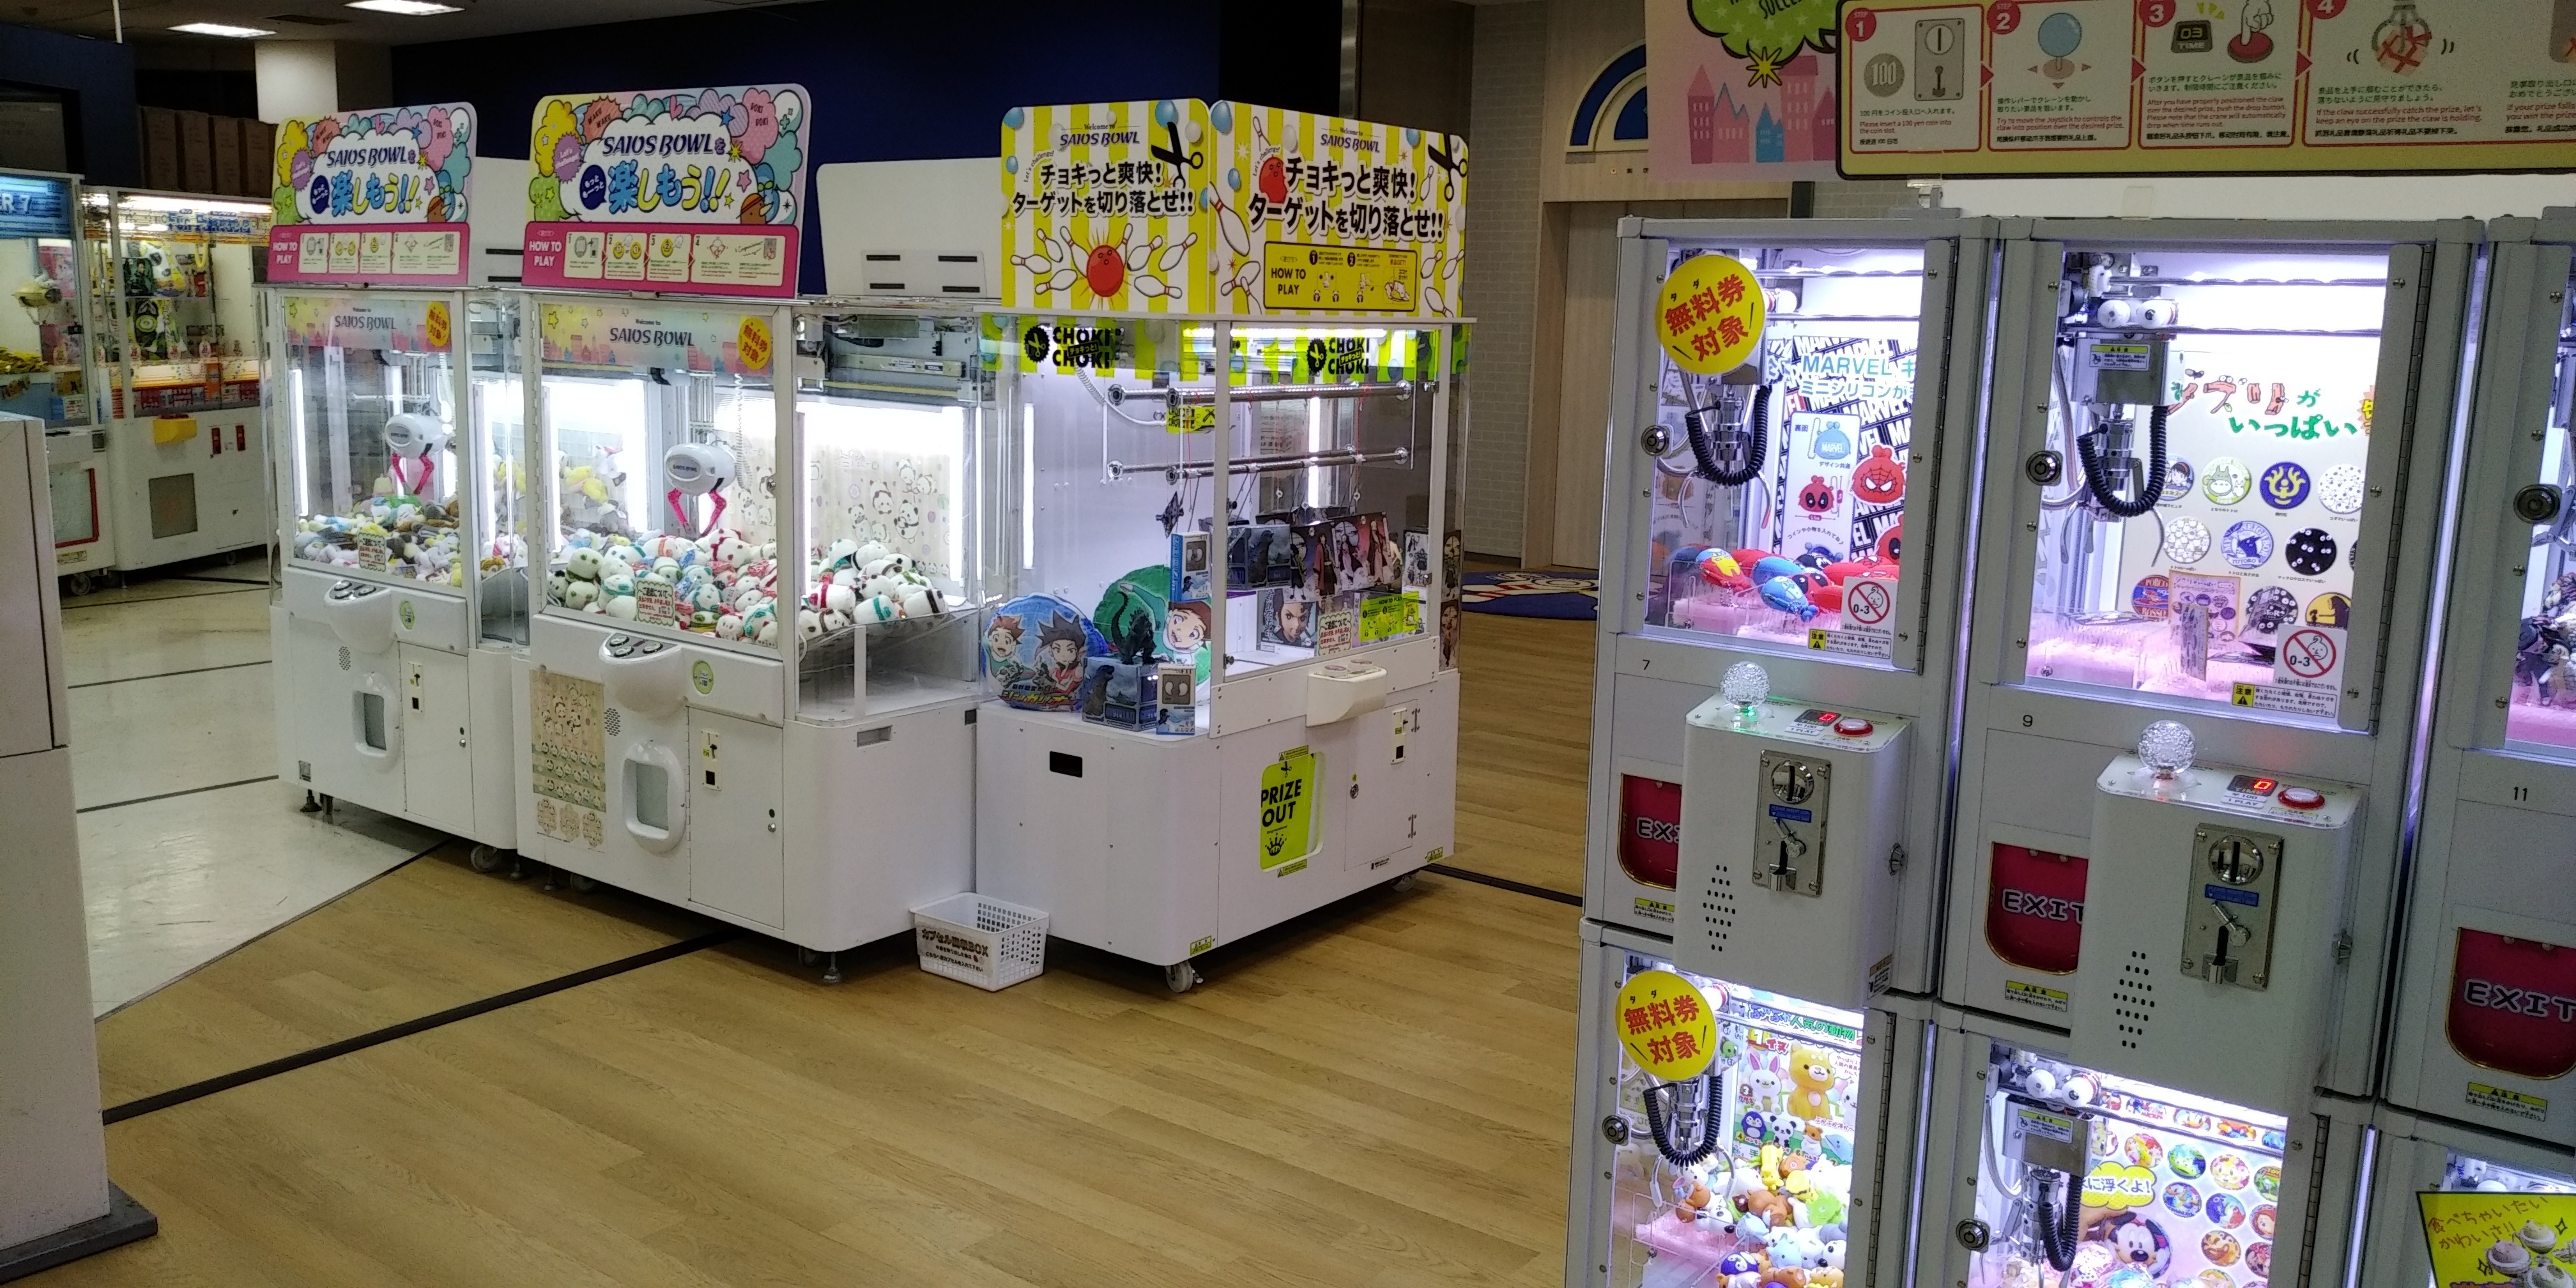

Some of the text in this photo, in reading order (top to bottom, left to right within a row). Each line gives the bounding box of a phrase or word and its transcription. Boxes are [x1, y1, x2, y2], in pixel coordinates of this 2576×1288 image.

[2149, 4, 2165, 23] 3
[2317, 0, 2335, 14] 4
[1856, 21, 1864, 37] 1
[1997, 13, 2011, 30] 2
[2180, 27, 2203, 40] 03
[1871, 61, 1896, 86] 100
[2220, 97, 2255, 105] positioned
[2535, 103, 2556, 112] prize
[2047, 116, 2073, 124] Joystick
[2356, 107, 2401, 116] successfully
[2387, 116, 2406, 124] prize
[602, 134, 656, 156] SAIOS
[1060, 131, 1140, 147] SAIOS BOWL
[1320, 134, 1381, 153] SAIOS BOWL
[326, 148, 366, 167] SAIOS
[1040, 160, 1163, 187] チョキっと爽快!
[1285, 157, 1416, 200] チョキっと爽快!
[20, 194, 31, 213] 7
[1012, 191, 1196, 215] ターゲットを切り落とせ!!
[1248, 194, 1445, 238] ターゲットを切り落とせ!!
[528, 241, 562, 252] HOW TO
[533, 255, 555, 267] PLAY
[1271, 268, 1307, 280] HOW TO
[1277, 284, 1300, 295] PLAY
[1664, 273, 1746, 337] 無料券
[335, 314, 396, 331] SAIOS BOWL
[610, 327, 695, 348] SAIOS BOWL
[1053, 326, 1110, 347] CHOKI
[1328, 337, 1370, 353] CHOKI
[1690, 315, 1749, 362] 対象
[1052, 349, 1110, 369] CHOKI
[1328, 358, 1370, 375] CHOKI
[1802, 355, 1892, 376] MARVEL
[2228, 413, 2358, 440] いっぱい
[1821, 441, 1844, 454] MARVEL
[1853, 604, 1870, 615] 0-3
[2142, 607, 2167, 617] ROSSO
[1642, 660, 1650, 670] 7
[2290, 654, 2311, 668] 0-3
[2022, 714, 2034, 728] 9
[1261, 778, 1303, 808] PRIZE
[2512, 786, 2529, 802] 11
[1262, 801, 1296, 828] OUT
[2464, 978, 2576, 1023] EXIT
[1623, 994, 1701, 1036] 無料券
[1647, 1031, 1701, 1065] 対象
[1766, 1038, 1789, 1055] イヌ
